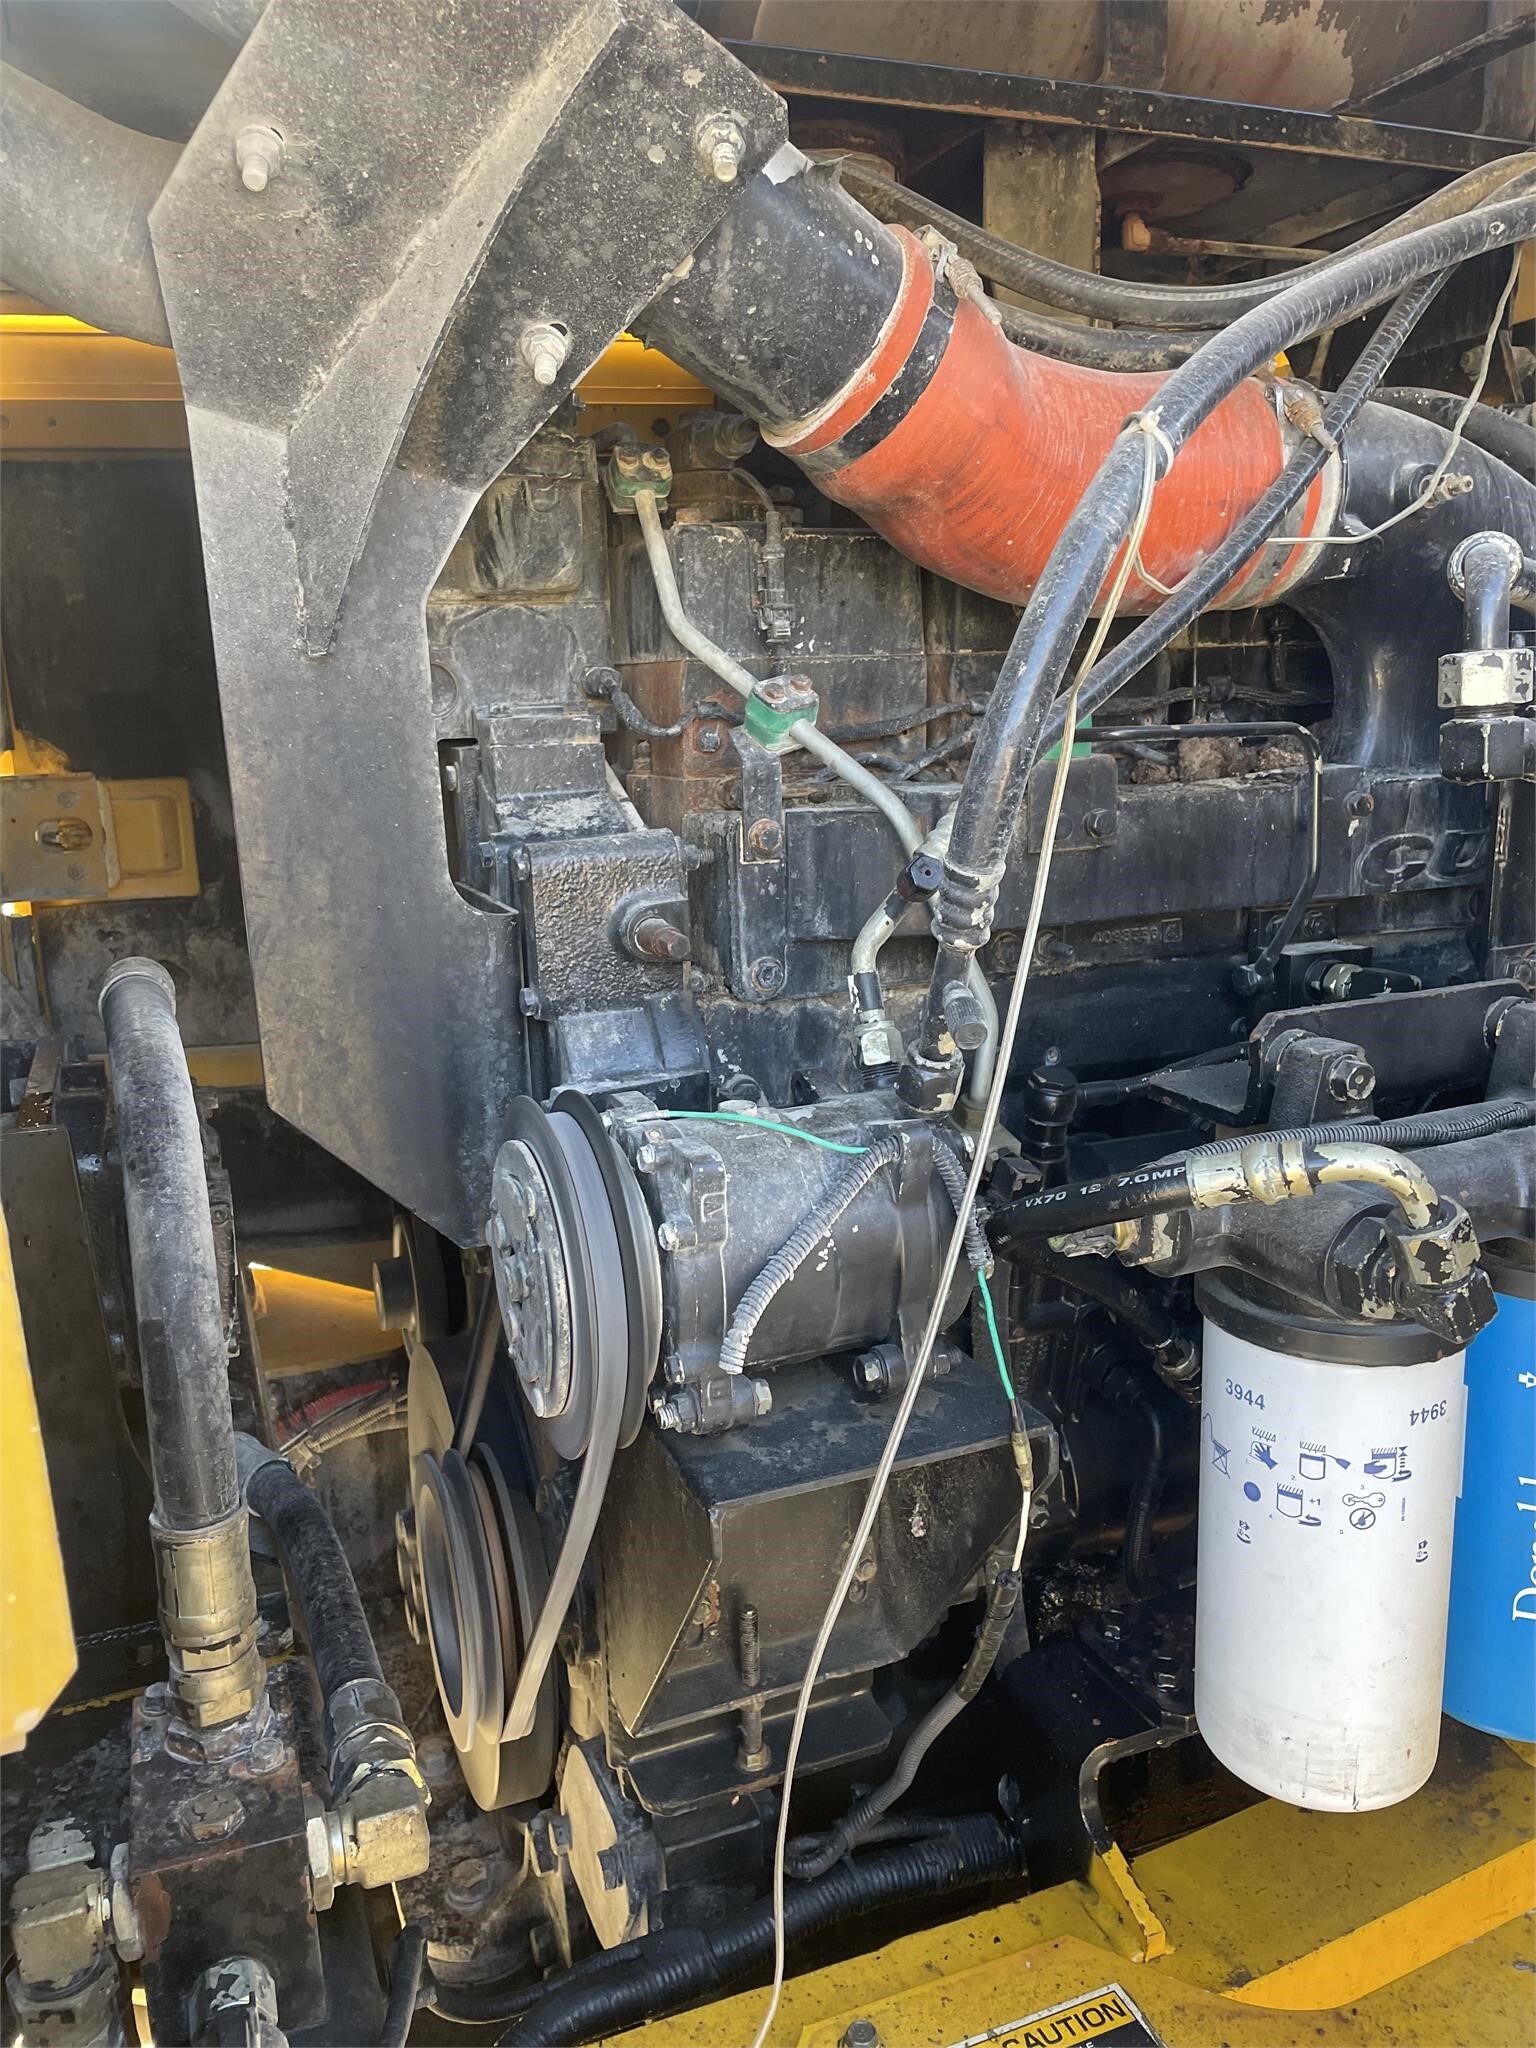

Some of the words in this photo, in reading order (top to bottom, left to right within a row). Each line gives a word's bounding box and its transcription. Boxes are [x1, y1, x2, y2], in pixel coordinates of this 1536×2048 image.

[1025, 1191, 1067, 1209] VX70
[1224, 1378, 1266, 1411] 3944
[1409, 1399, 1447, 1426] 3944
